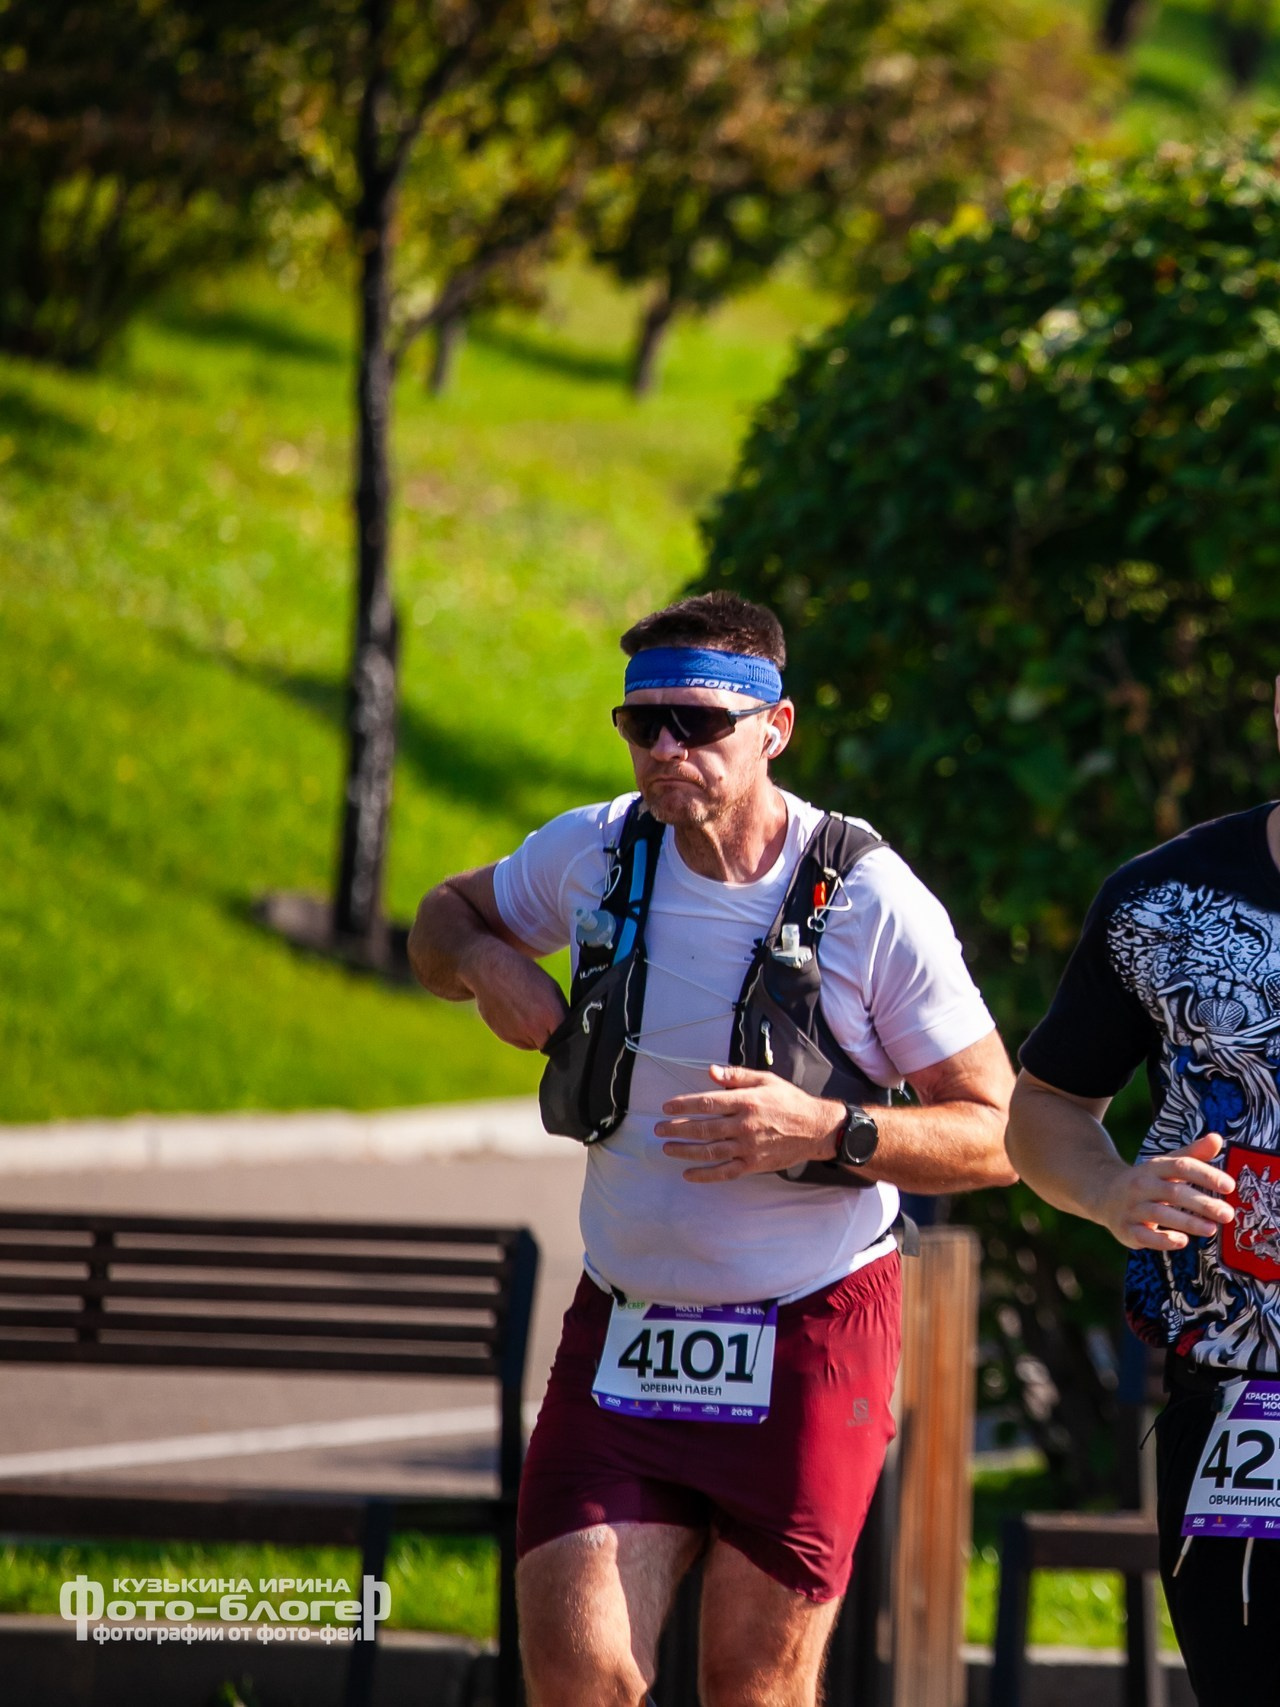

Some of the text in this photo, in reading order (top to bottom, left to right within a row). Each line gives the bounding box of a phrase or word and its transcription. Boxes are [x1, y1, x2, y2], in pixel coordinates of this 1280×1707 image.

[618, 1328, 753, 1384] 4101
[640, 1383, 722, 1396] ЮРЕВИЧ ПАВЕЛ
[731, 1407, 753, 1417] 2026
